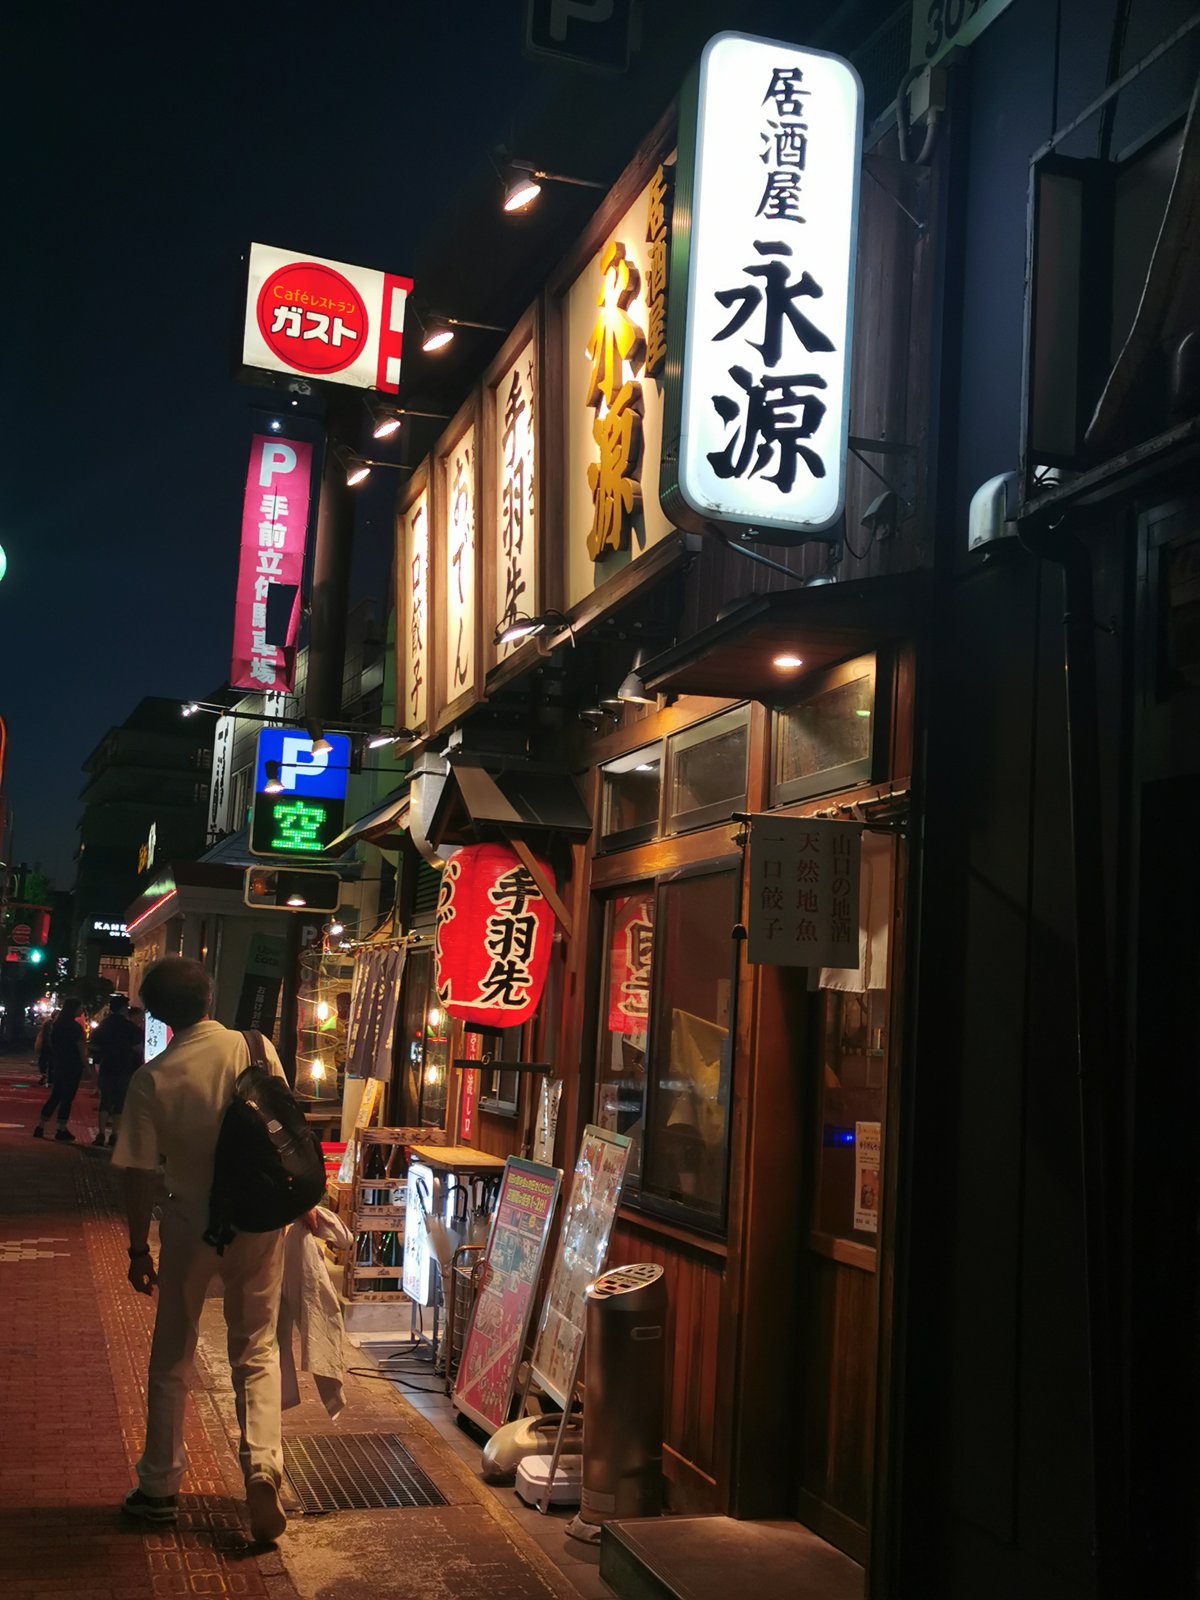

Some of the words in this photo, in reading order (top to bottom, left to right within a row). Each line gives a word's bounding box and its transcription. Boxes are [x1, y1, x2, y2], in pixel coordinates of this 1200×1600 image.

[754, 67, 812, 224] 居酒屋
[645, 163, 667, 373] 居酒屋
[271, 305, 357, 347] ガスト
[707, 239, 837, 494] 永源
[585, 241, 641, 561] 永源
[258, 441, 297, 487] P
[452, 449, 469, 688] おでん
[280, 737, 329, 790] P
[271, 802, 327, 851] 空
[480, 866, 542, 1006] 手羽先
[760, 836, 785, 941] 一口餃子
[795, 832, 821, 943] 天然地魚
[831, 833, 851, 944] 山口の地酒
